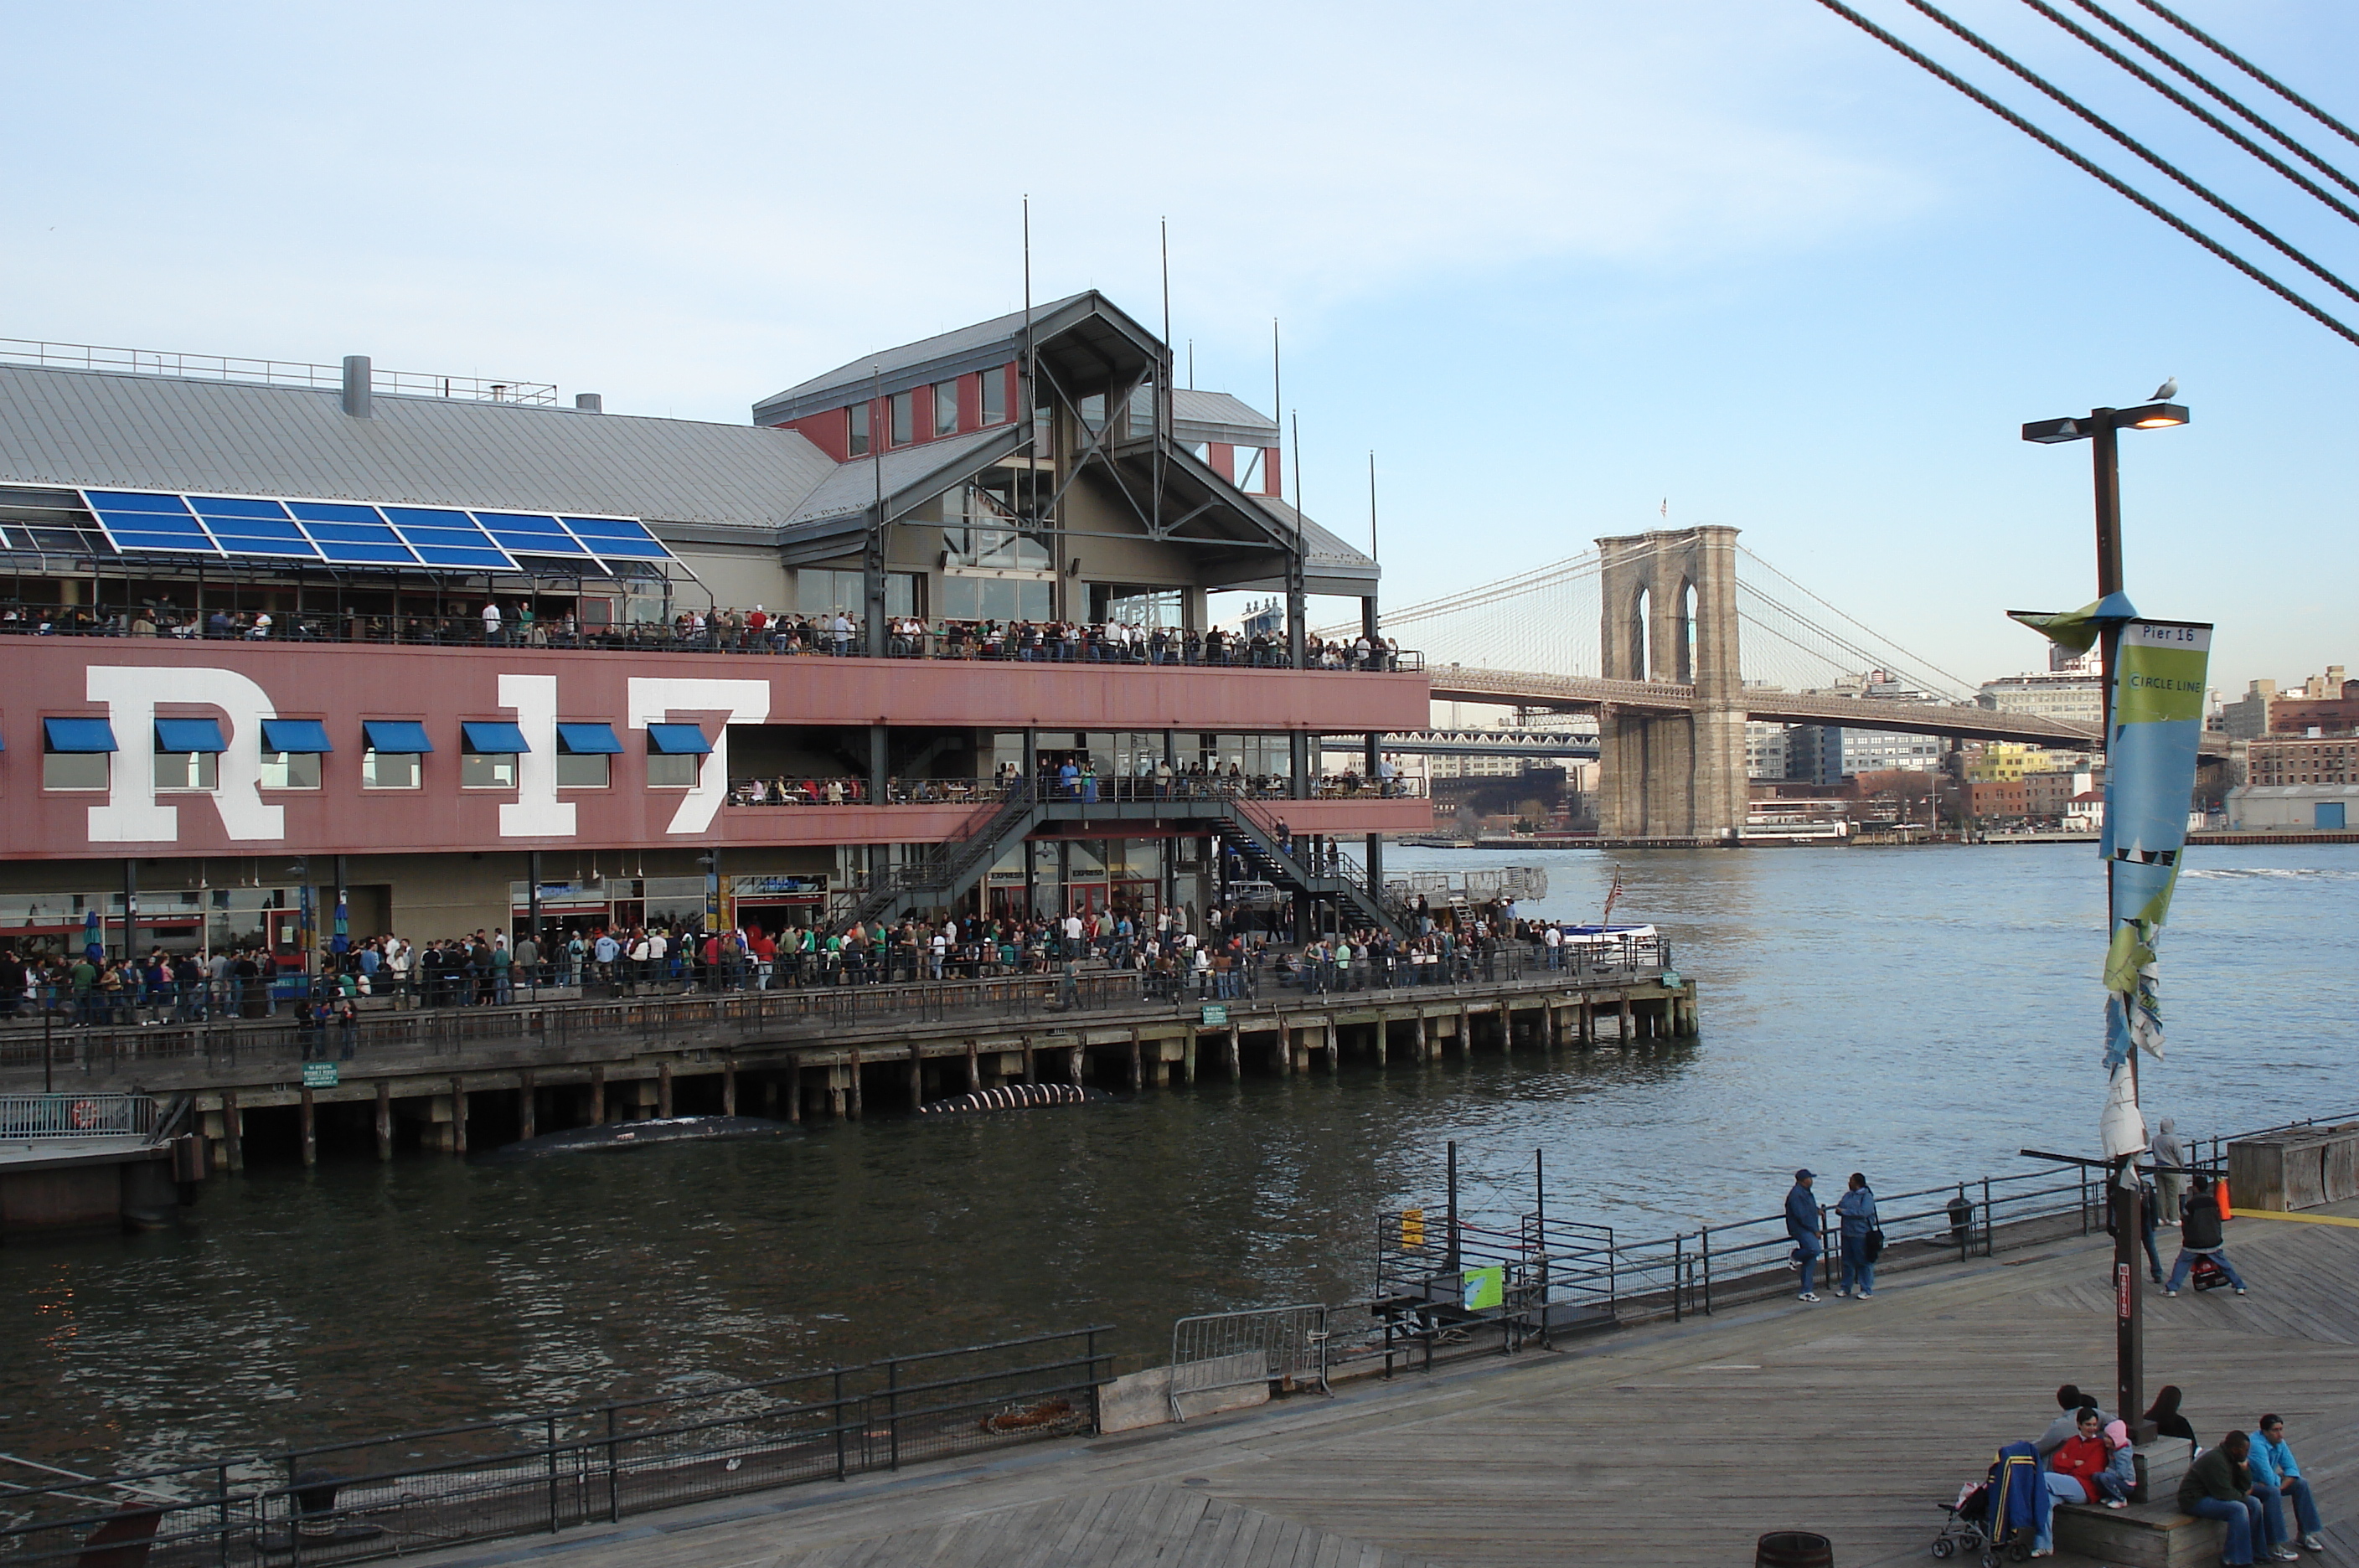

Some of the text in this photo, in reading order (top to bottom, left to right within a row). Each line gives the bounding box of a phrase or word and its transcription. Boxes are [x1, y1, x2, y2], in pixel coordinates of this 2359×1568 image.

[2143, 626, 2195, 642] Pier 16
[2129, 673, 2202, 694] CIRCLE LINE
